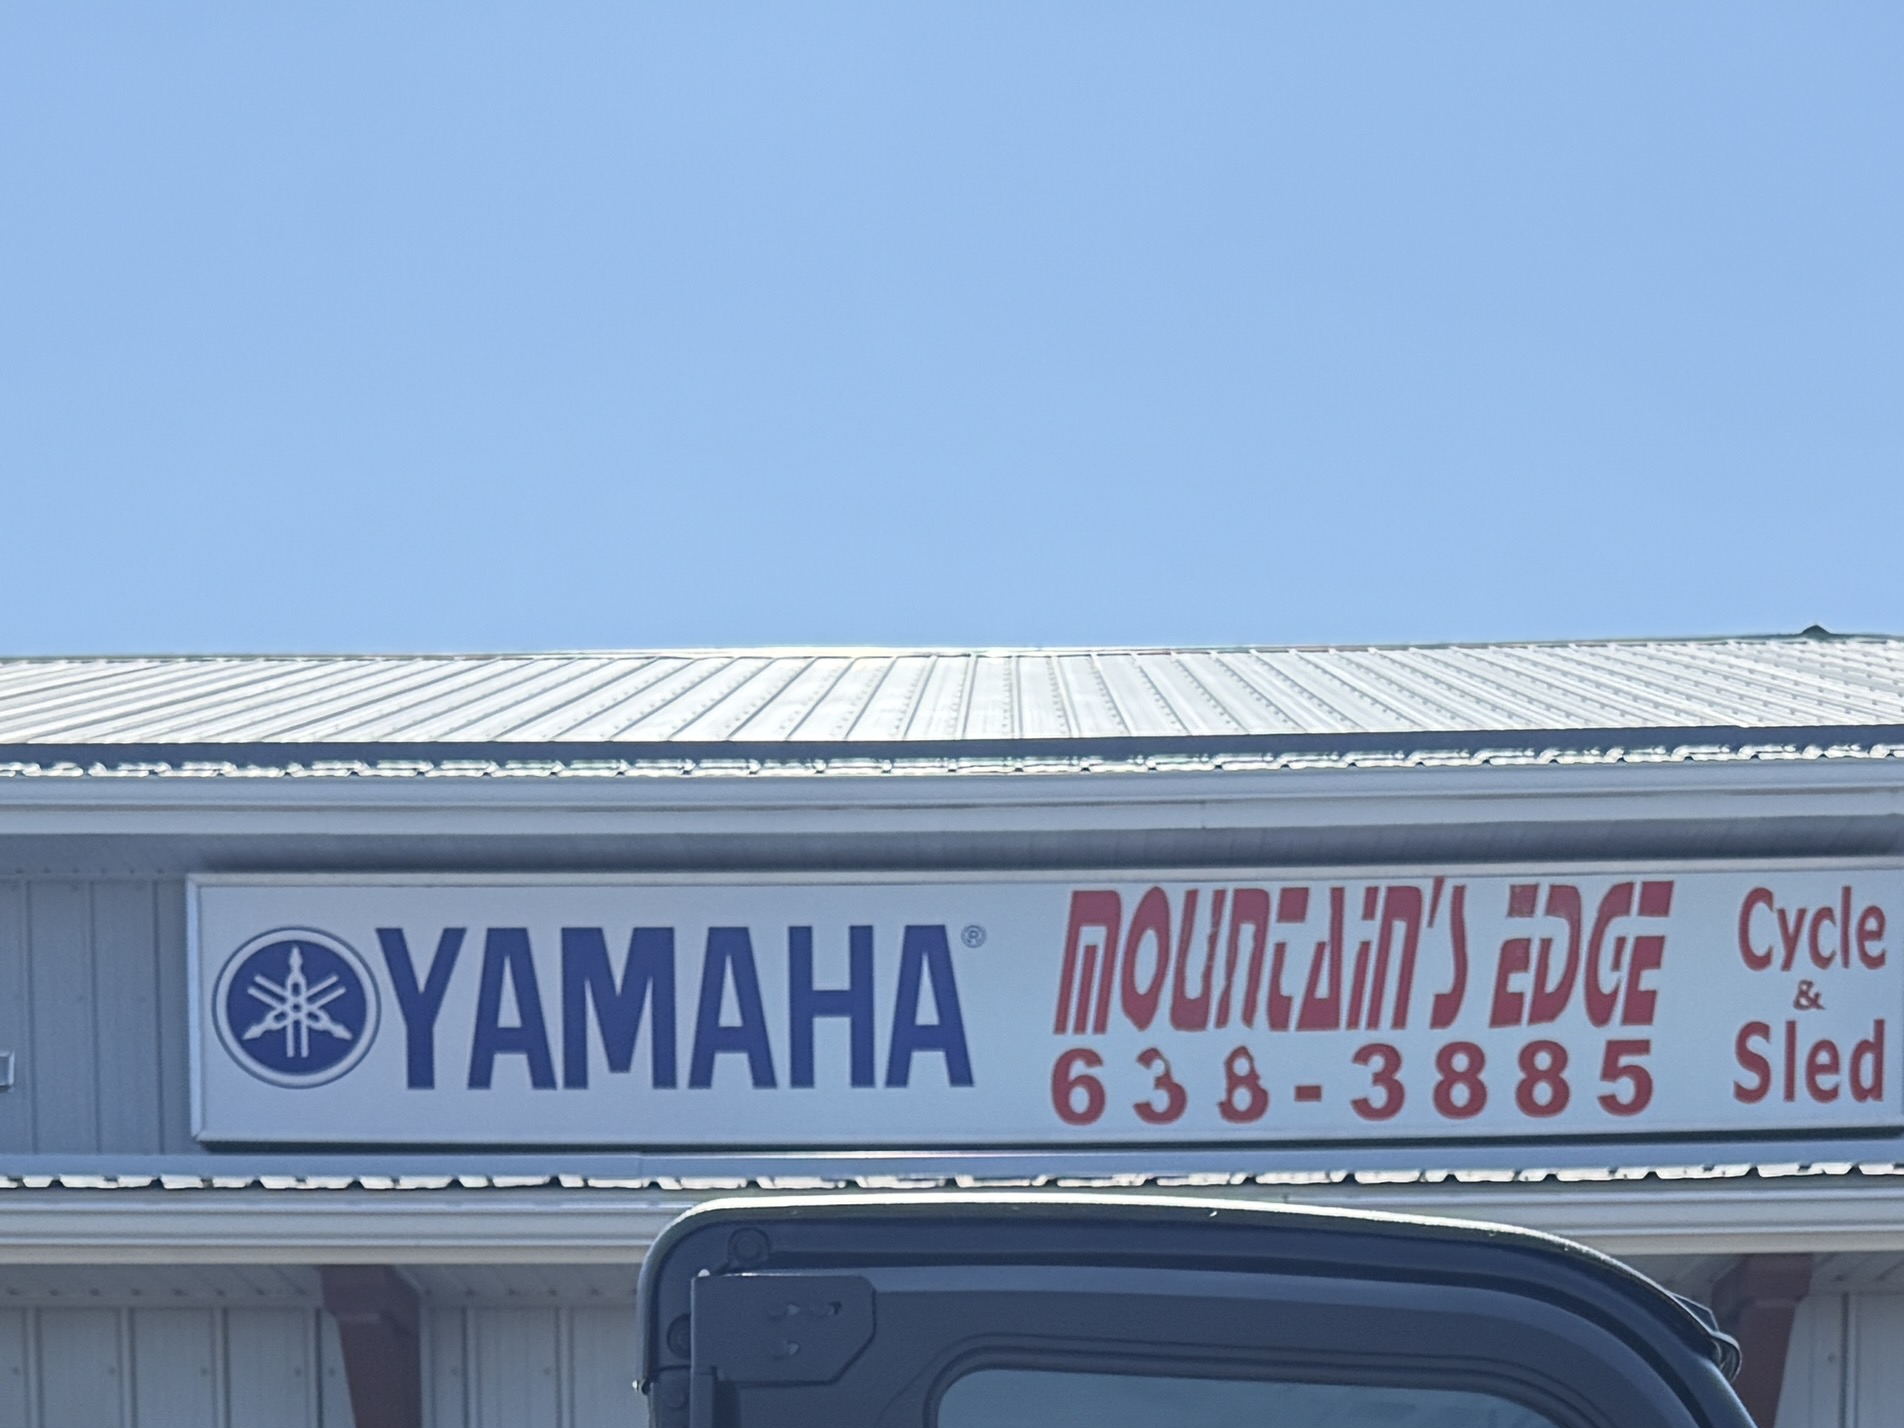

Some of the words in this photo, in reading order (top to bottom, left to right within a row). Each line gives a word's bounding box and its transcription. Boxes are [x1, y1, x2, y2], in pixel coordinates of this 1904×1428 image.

[1053, 876, 1468, 1034] MOUNTAIN'S
[1489, 880, 1674, 1028] EDGE
[1739, 886, 1887, 971] Cycle
[375, 925, 975, 1091] YAMAHA
[1793, 981, 1824, 1010] &
[1052, 1039, 1654, 1125] 638-3885
[1734, 1019, 1886, 1104] Sled
